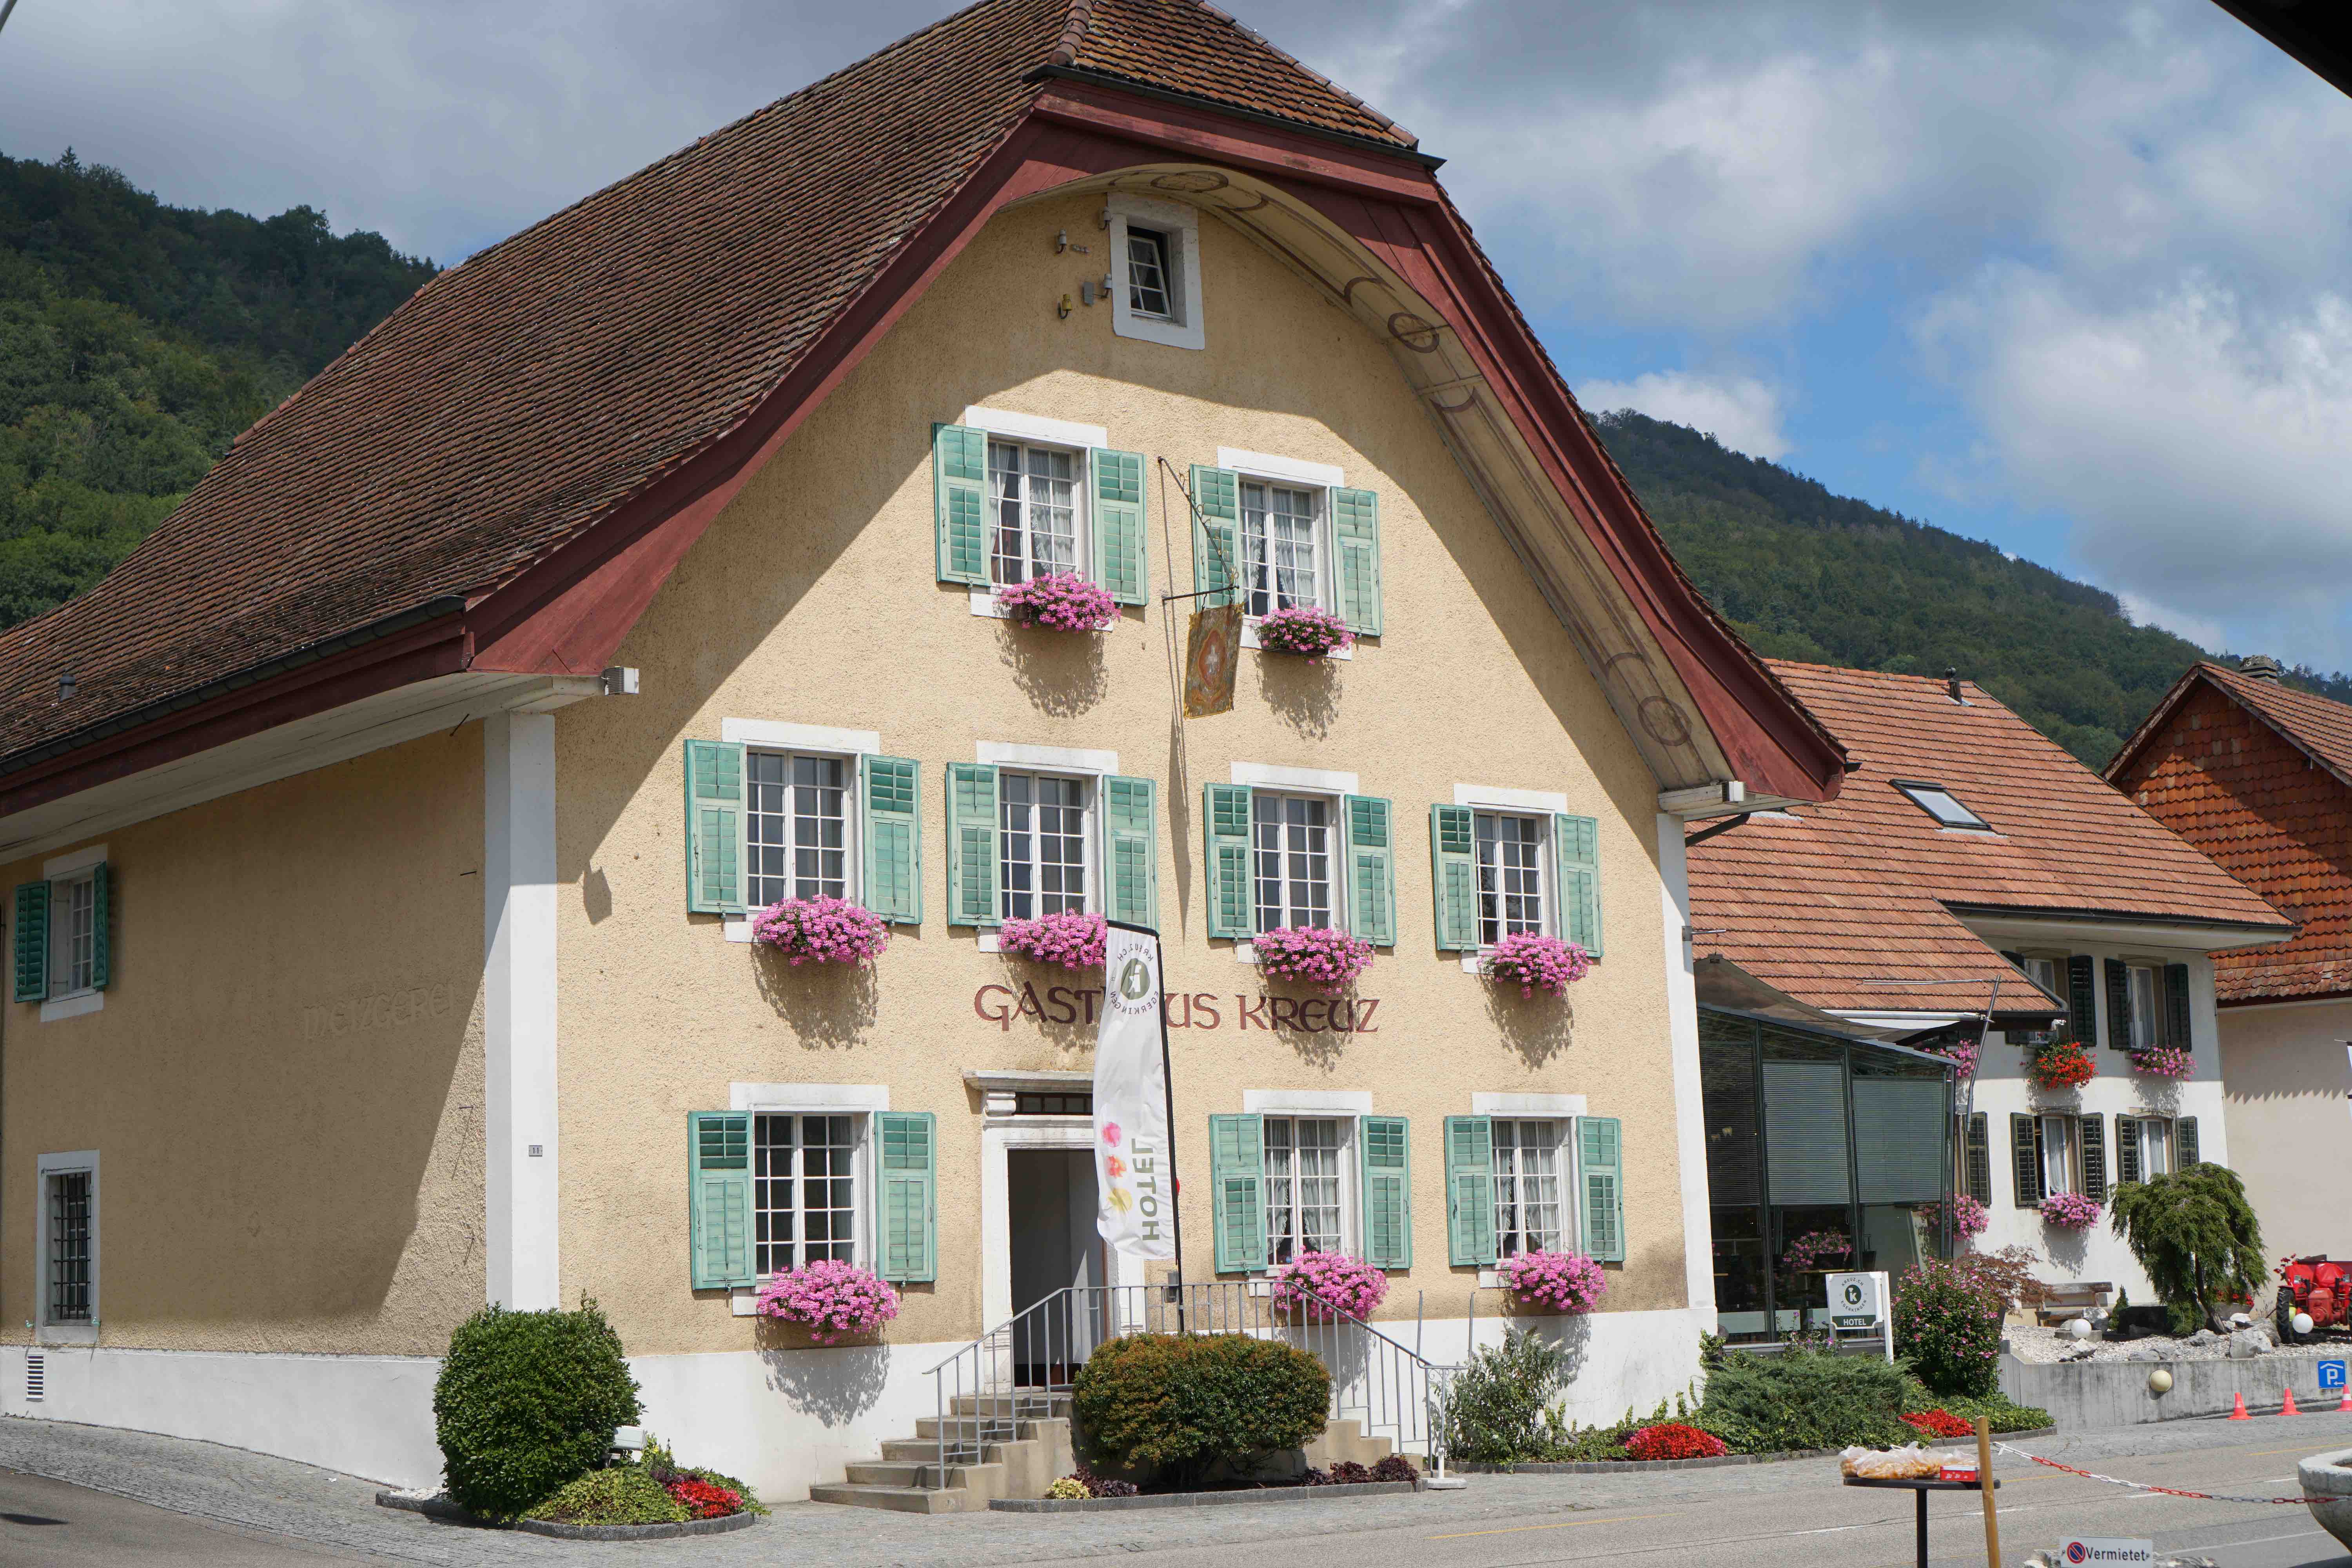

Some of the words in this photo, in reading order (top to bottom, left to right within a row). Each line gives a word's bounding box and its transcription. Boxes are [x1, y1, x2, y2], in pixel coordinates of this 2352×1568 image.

[975, 981, 1220, 1031] GASTUS
[1235, 994, 1380, 1033] KREUZ
[1842, 1278, 1863, 1286] KREUZ.CH
[1841, 1300, 1866, 1312] EGERKINGEN
[2327, 1368, 2337, 1385] P
[2085, 1547, 2145, 1561] Vermietet
